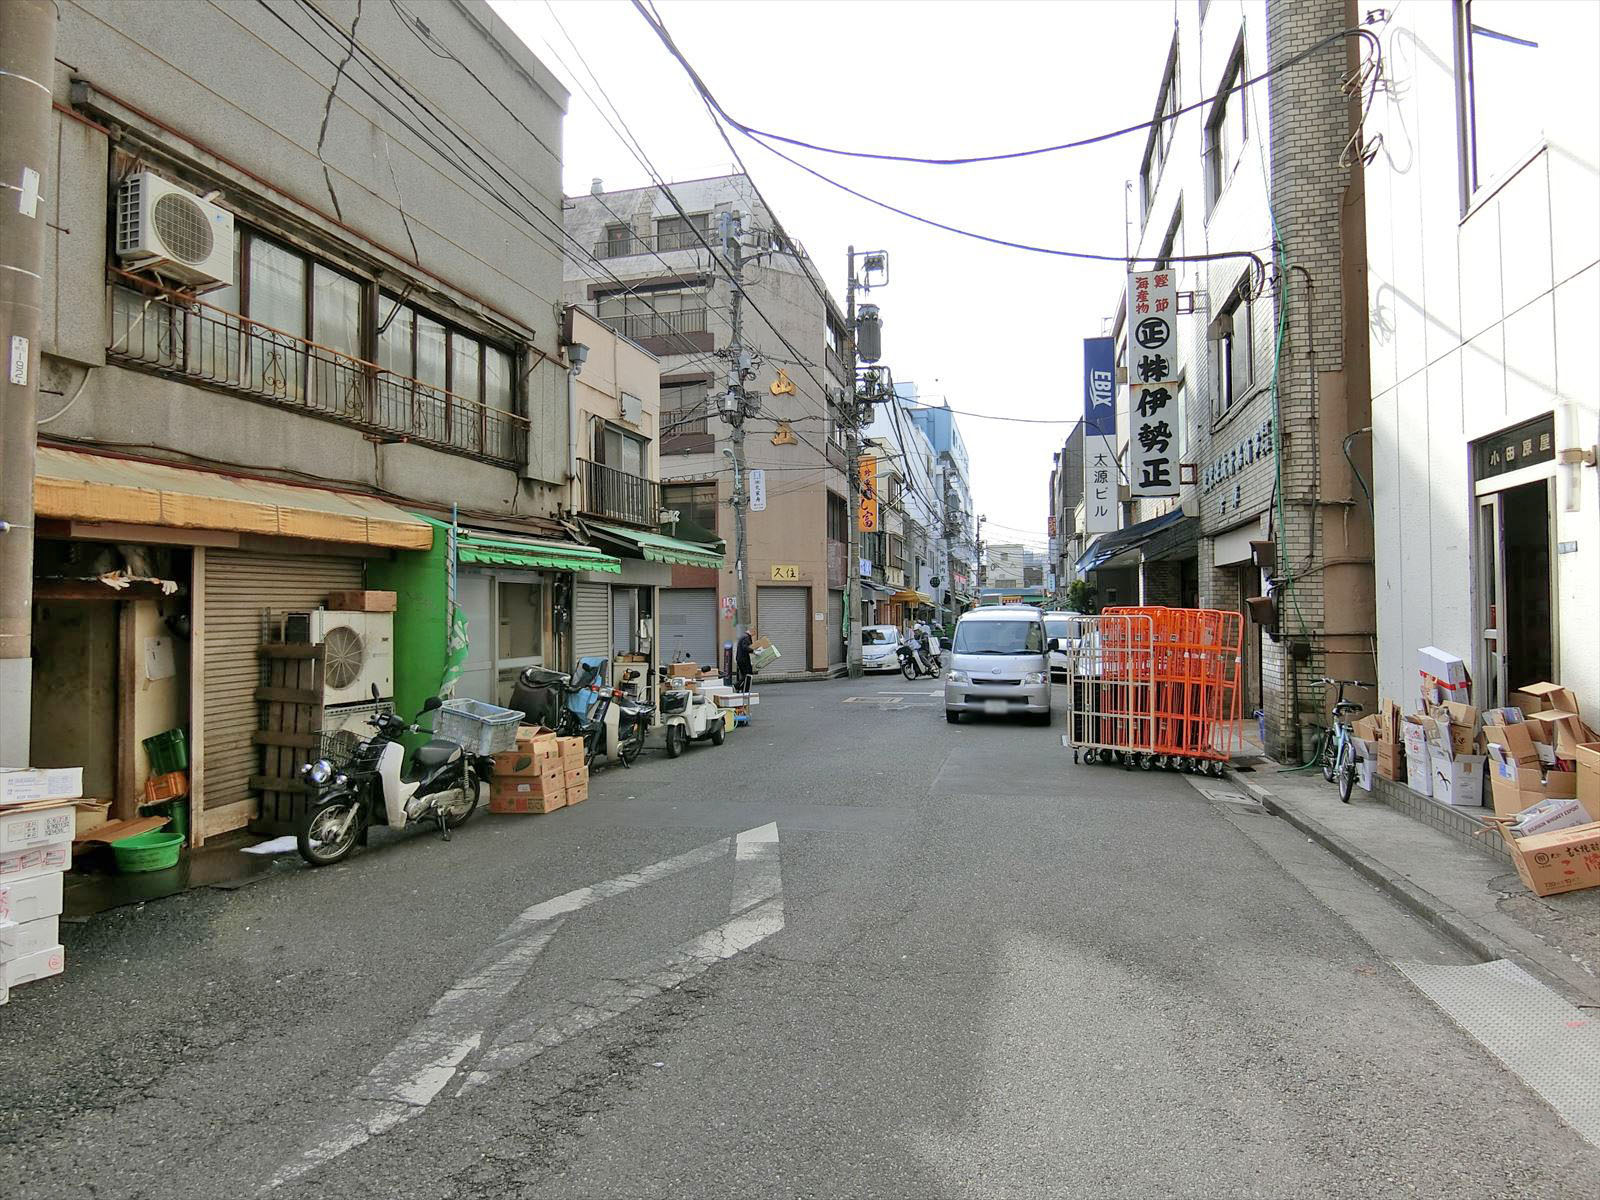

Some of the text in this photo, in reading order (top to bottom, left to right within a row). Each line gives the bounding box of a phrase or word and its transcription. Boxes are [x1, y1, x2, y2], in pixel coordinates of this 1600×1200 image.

[1135, 276, 1150, 314] 海産物
[1153, 274, 1169, 313] 鰹節
[1093, 369, 1112, 408] EBIX
[1489, 432, 1550, 466] 小田原屋
[1093, 453, 1109, 518] 太源ビル
[773, 567, 797, 579] 久住
